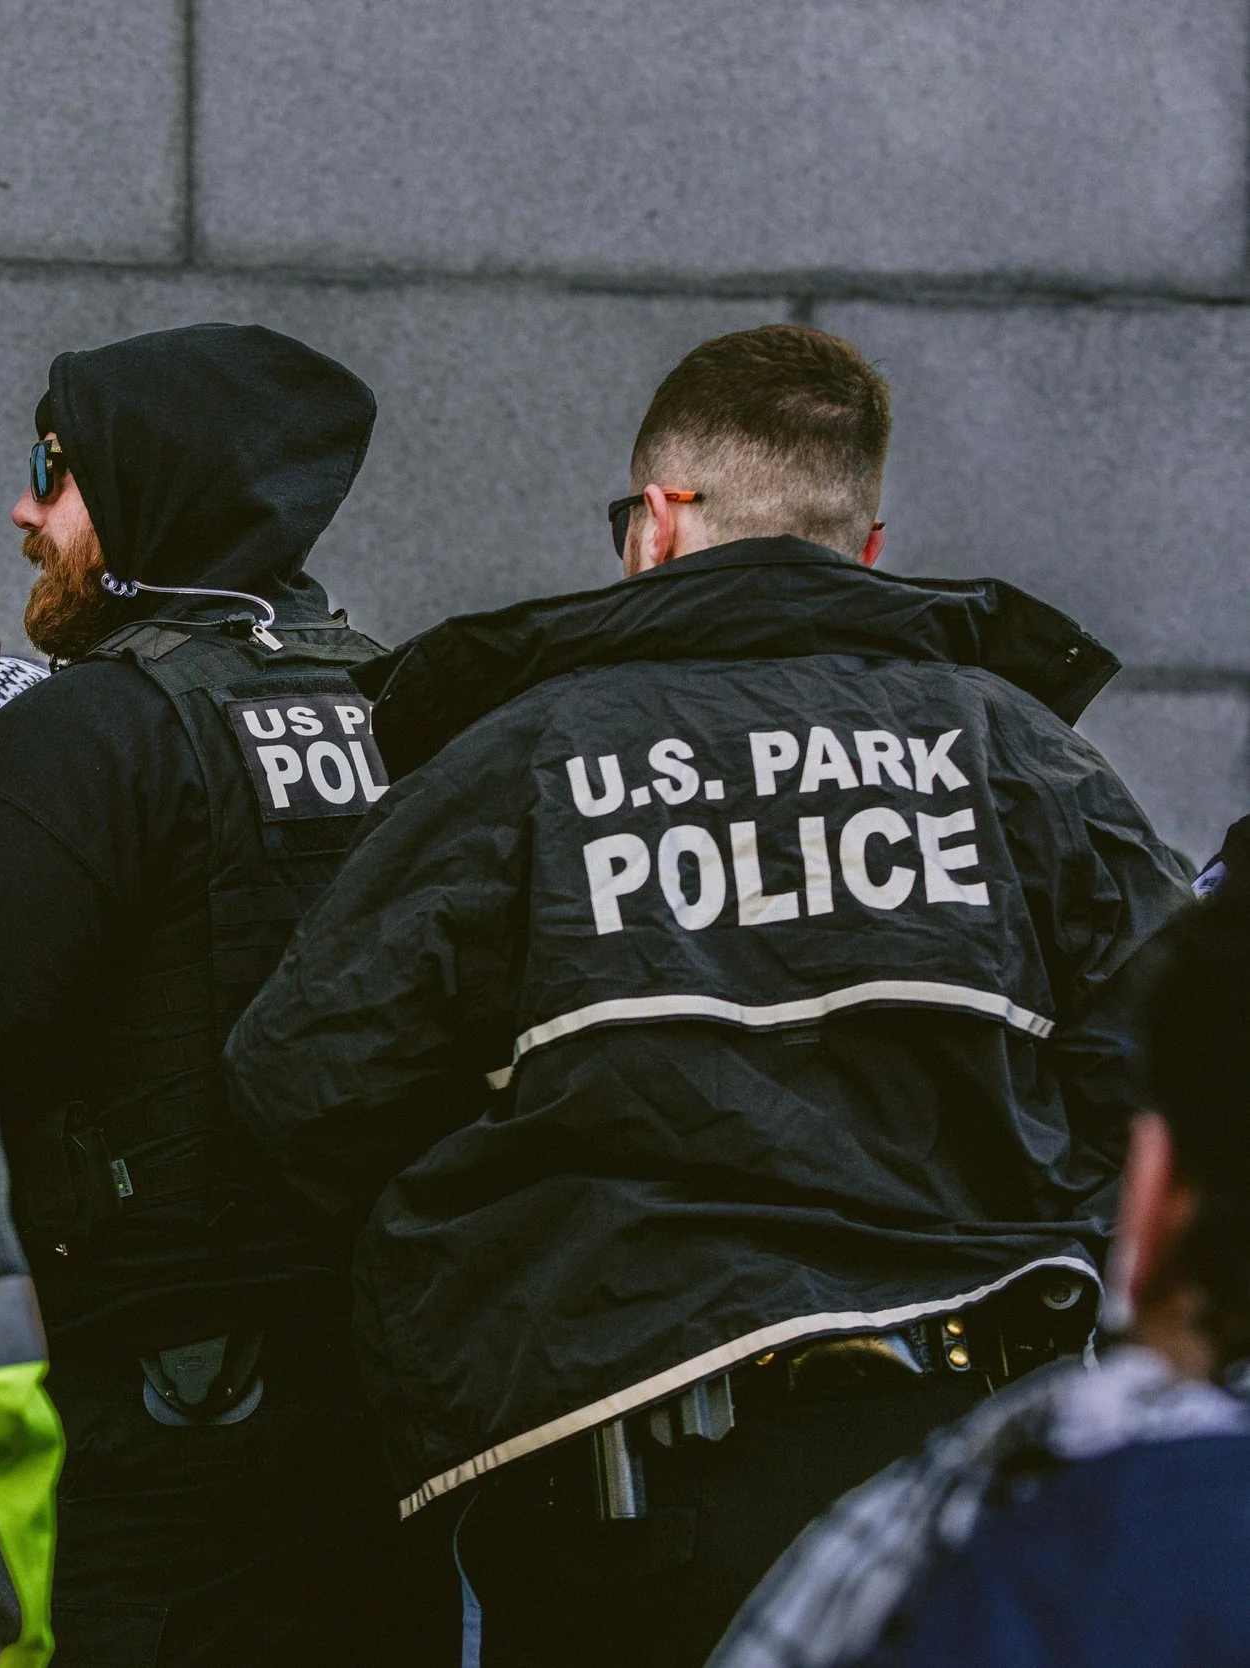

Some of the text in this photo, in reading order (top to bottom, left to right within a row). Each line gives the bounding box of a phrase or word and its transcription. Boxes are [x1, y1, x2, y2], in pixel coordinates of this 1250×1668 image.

[242, 705, 373, 739] US P
[565, 726, 970, 818] U.S. PARK
[582, 807, 990, 936] POLICE
